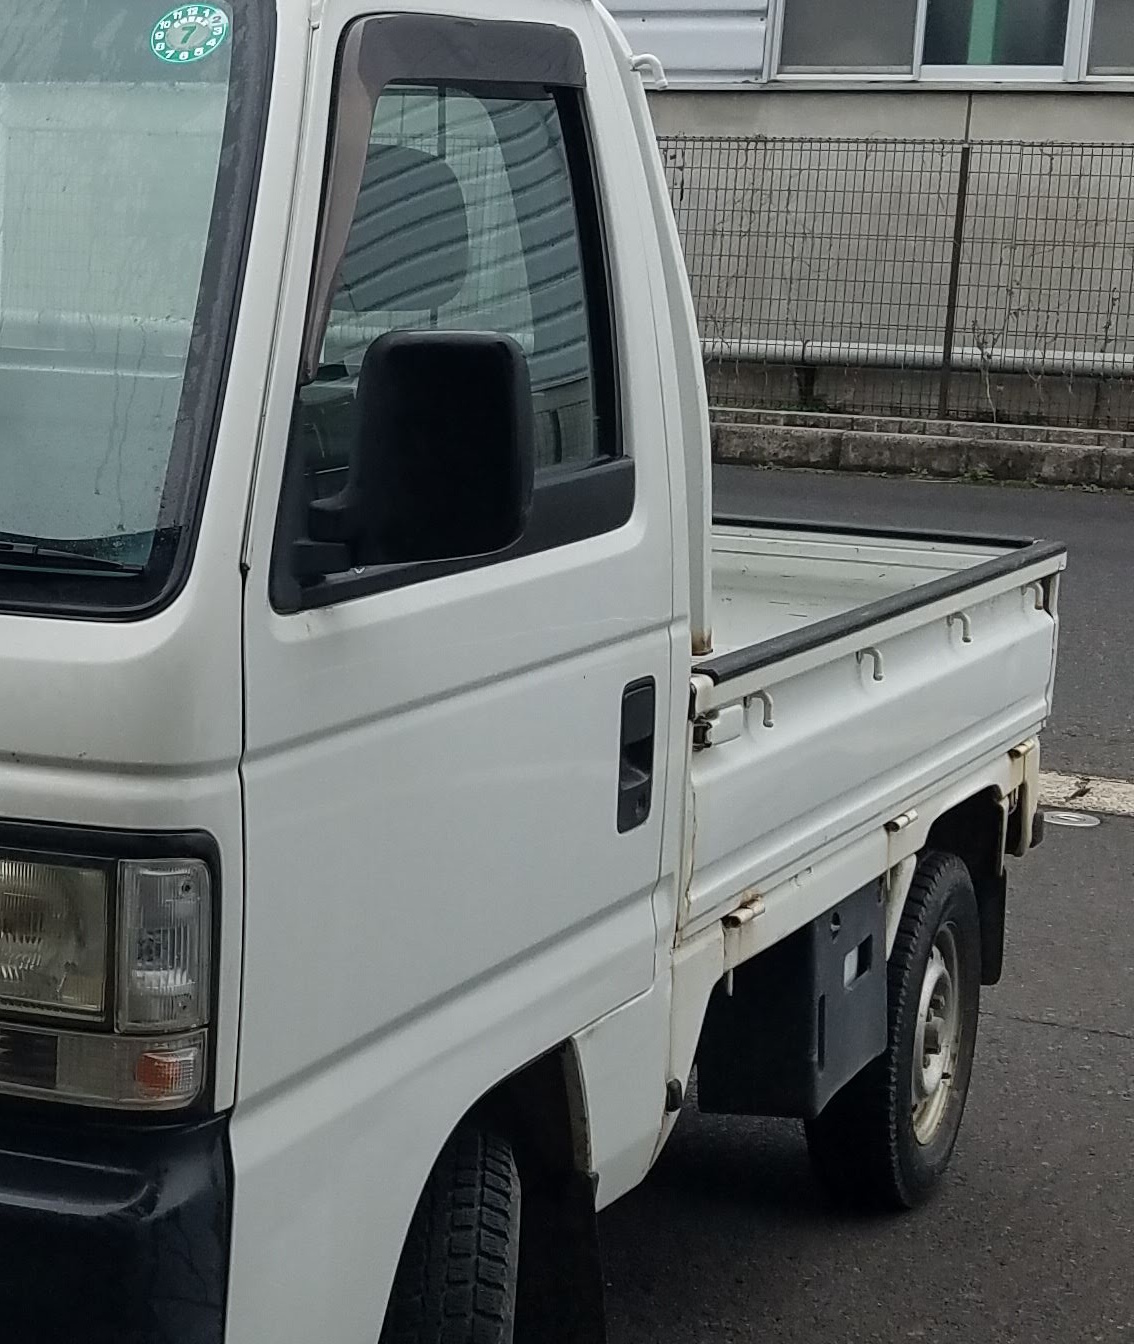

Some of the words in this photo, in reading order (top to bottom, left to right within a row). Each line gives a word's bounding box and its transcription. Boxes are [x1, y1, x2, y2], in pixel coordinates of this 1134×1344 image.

[173, 10, 183, 20] 11
[187, 6, 198, 16] 12
[203, 9, 210, 17] 1
[212, 15, 222, 23] 2
[159, 20, 171, 30] 10
[181, 25, 197, 44] 7
[212, 26, 223, 35] 3
[155, 31, 165, 40] 9
[206, 38, 217, 47] 4
[165, 49, 175, 59] 7
[179, 51, 189, 60] 6
